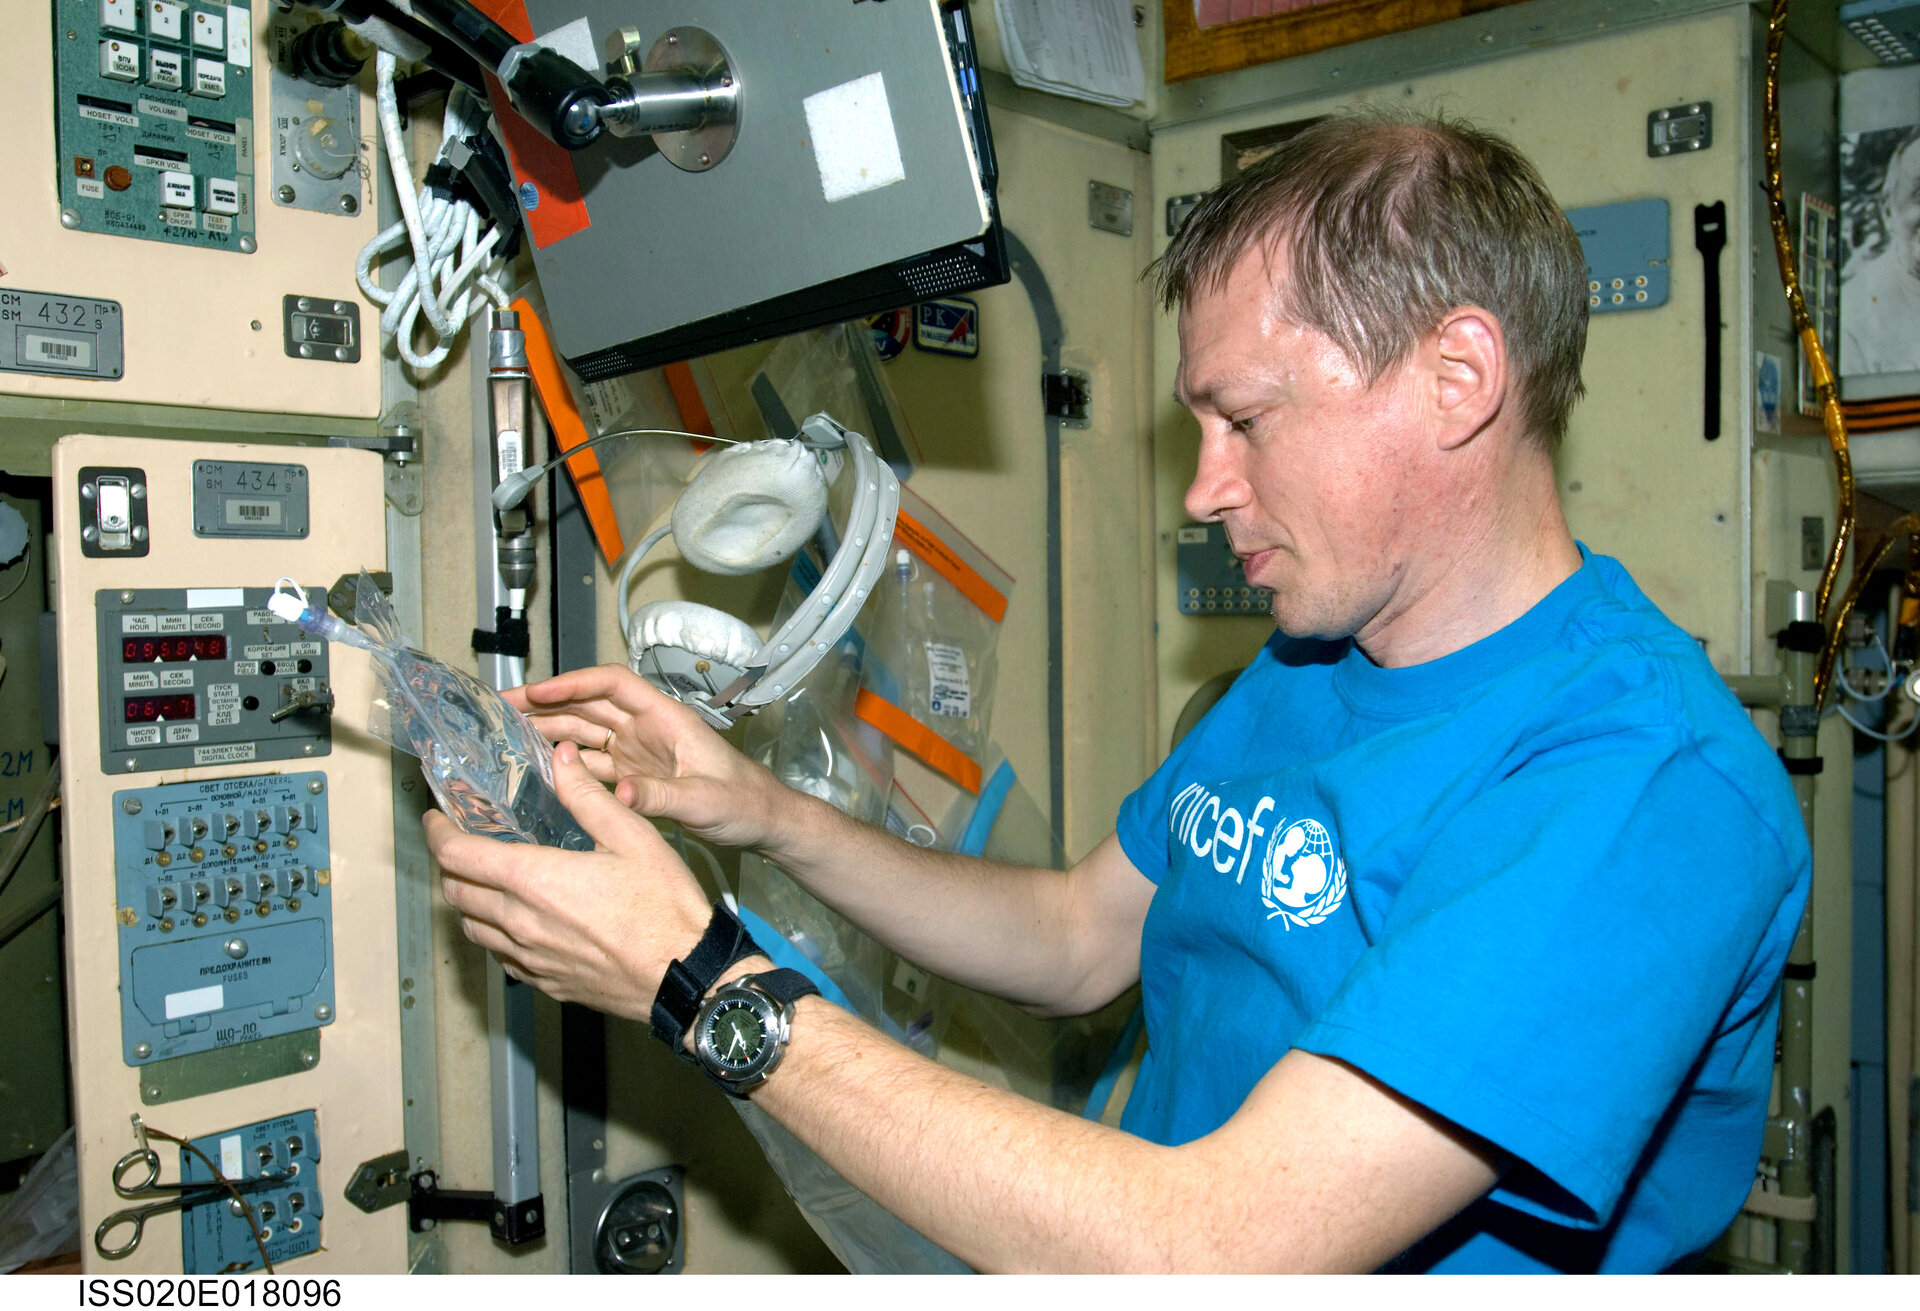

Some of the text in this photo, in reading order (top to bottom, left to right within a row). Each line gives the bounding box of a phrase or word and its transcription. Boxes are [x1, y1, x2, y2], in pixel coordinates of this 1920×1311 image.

[118, 8, 123, 16] 1
[116, 64, 136, 72] ICOM
[157, 75, 176, 83] PAGE
[203, 82, 220, 91] XMIT
[149, 105, 178, 116] VOLUME
[87, 110, 134, 124] HDSET VOL1
[142, 131, 175, 142] ДИНАМИК
[187, 129, 231, 142] HDSET VOL2
[145, 158, 181, 170] SPKR VOL
[81, 184, 100, 192] FUSE
[173, 211, 190, 219] SPKR
[208, 223, 228, 231] RESET
[38, 302, 86, 326] 432
[94, 304, 109, 315] Пр
[2, 309, 21, 321] SM
[95, 319, 103, 330] S
[206, 479, 222, 489] SM
[236, 470, 278, 491] 434
[285, 483, 292, 493] S
[194, 621, 221, 629] SECOND
[247, 645, 286, 653] КОРРЕКЦИЯ
[128, 680, 154, 688] MINUTE
[163, 678, 191, 686] SECOND
[200, 783, 220, 793] СВЕТ
[145, 856, 153, 865] Д1
[177, 853, 186, 861] Д2
[210, 849, 218, 857] Д3
[180, 918, 189, 926] Д7
[272, 903, 284, 911] Д10
[200, 956, 271, 976] ПРЕДОХРАНИТЕЛИ
[223, 971, 248, 982] FUSES
